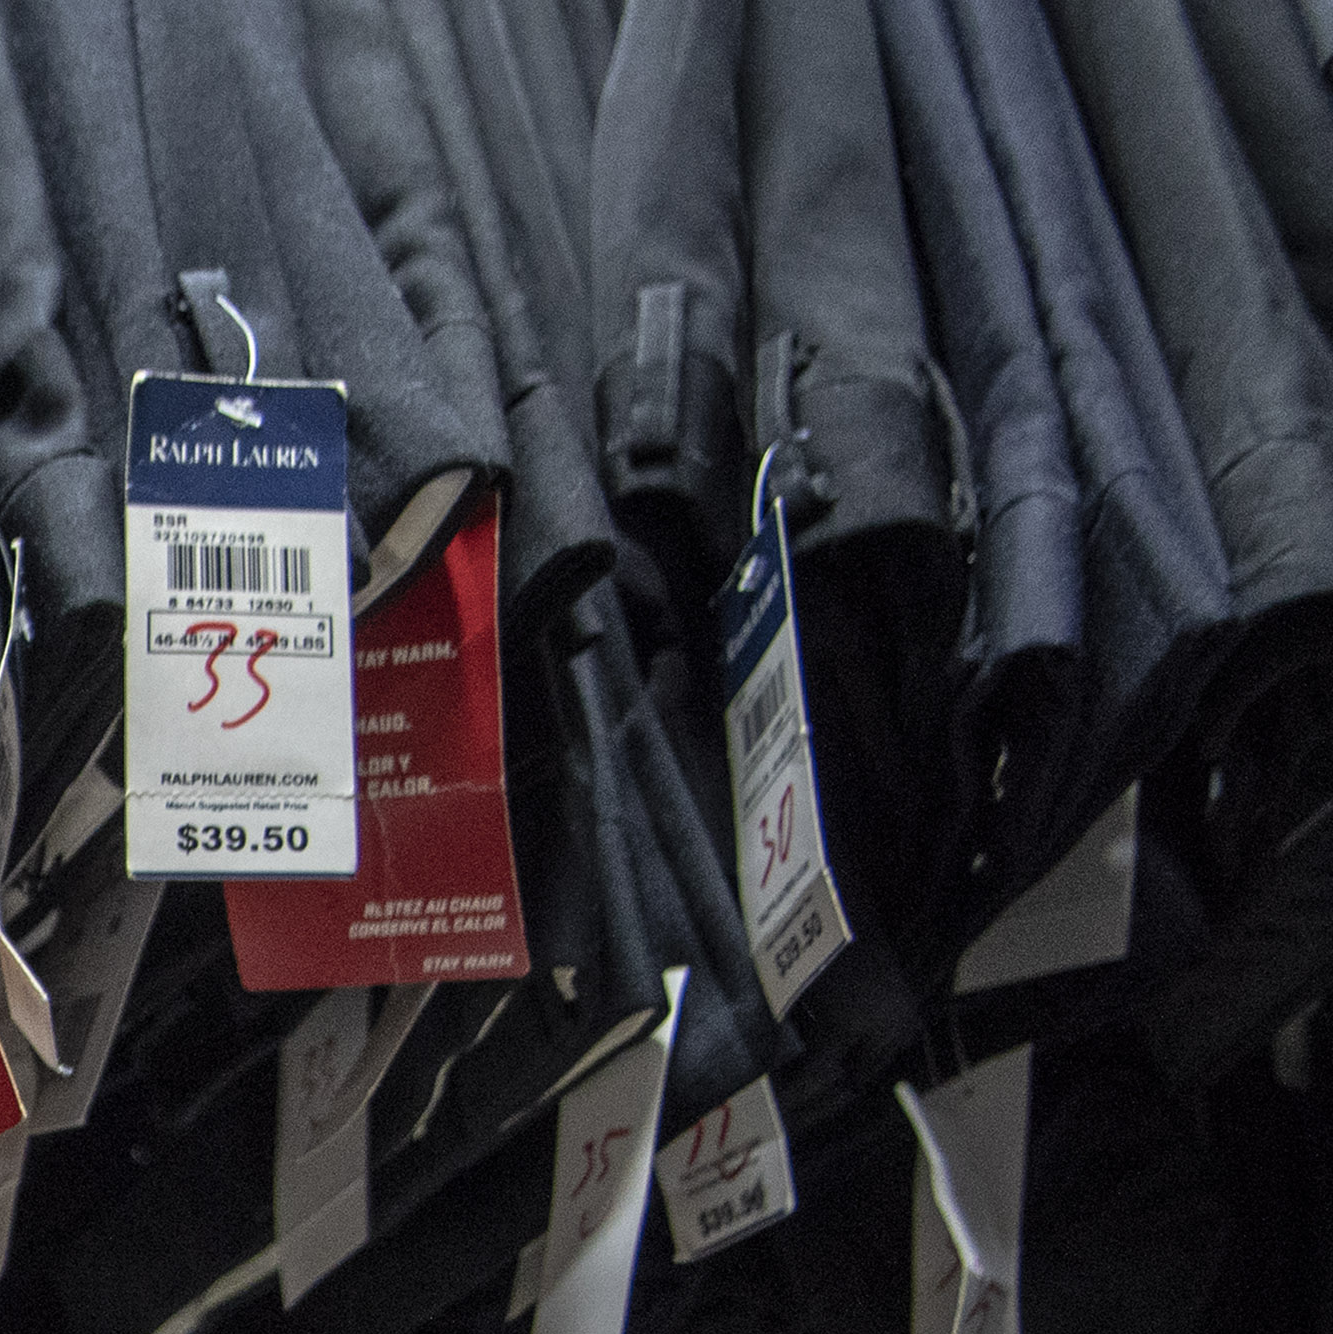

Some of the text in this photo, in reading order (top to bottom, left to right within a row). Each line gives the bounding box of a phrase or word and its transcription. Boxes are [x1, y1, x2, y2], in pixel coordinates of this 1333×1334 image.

[232, 437, 320, 469] LAUREN
[356, 645, 389, 669] TAY
[160, 772, 320, 787] RALPHLAUREN.COM
[176, 824, 310, 856] $39.50
